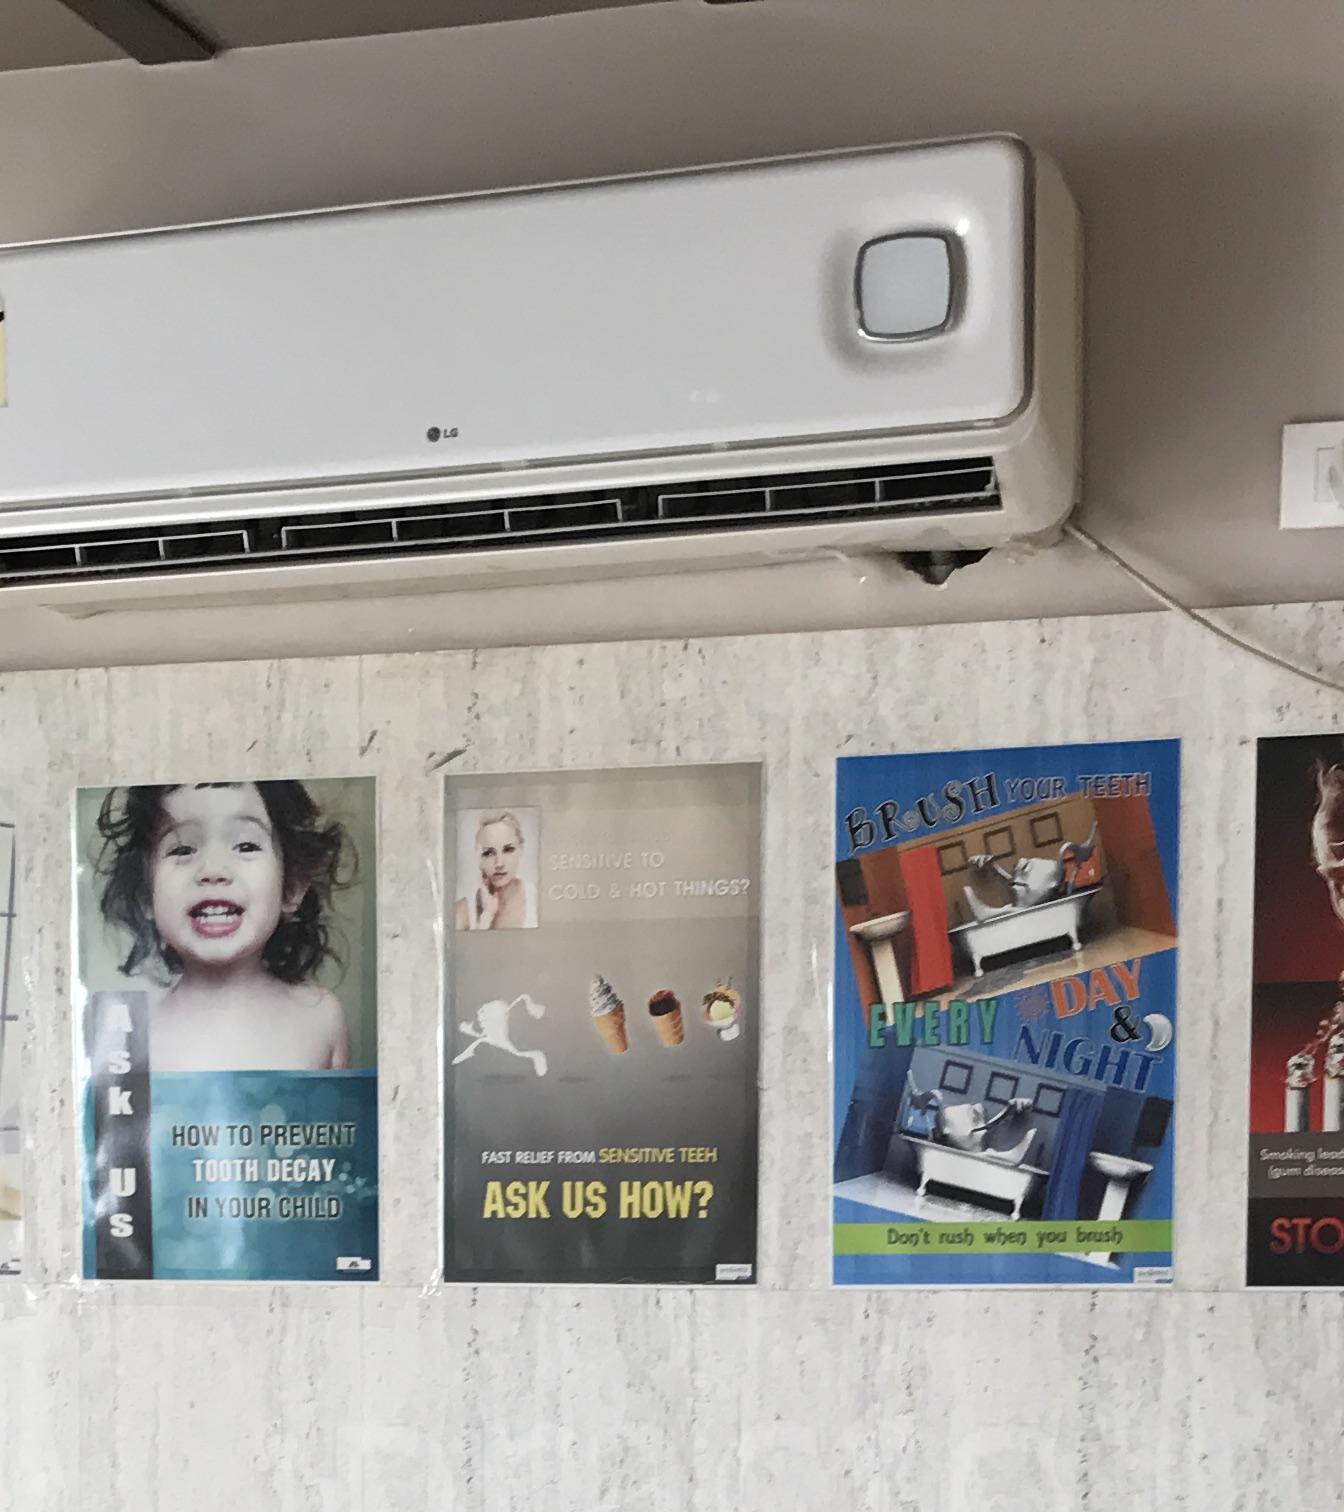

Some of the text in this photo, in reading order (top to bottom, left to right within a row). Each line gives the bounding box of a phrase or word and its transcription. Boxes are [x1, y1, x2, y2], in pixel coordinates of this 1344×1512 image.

[443, 427, 459, 439] LG
[843, 771, 1152, 857] BRUSH YOUR TEETH
[549, 851, 665, 872] SENSITIVE TO
[548, 878, 752, 901] COLD & HOT THINGS?
[867, 959, 1144, 1048] EVERY DAY
[1110, 1006, 1141, 1045] &
[1012, 1024, 1163, 1095] NIGHT
[172, 1122, 356, 1148] HOW TO PREVENT
[481, 1150, 512, 1165] FAST
[515, 1149, 554, 1164] RELIEF
[558, 1149, 596, 1164] FROM
[599, 1148, 675, 1164] SENSITIVE
[1259, 1148, 1316, 1163] Smoking
[192, 1158, 337, 1184] TOOTH DECAY
[1267, 1163, 1302, 1180] (gum
[187, 1196, 343, 1220] IN YOUR CHILD
[483, 1178, 714, 1219] ASK US HOW?
[887, 1227, 1123, 1248] Don't rush when you brush
